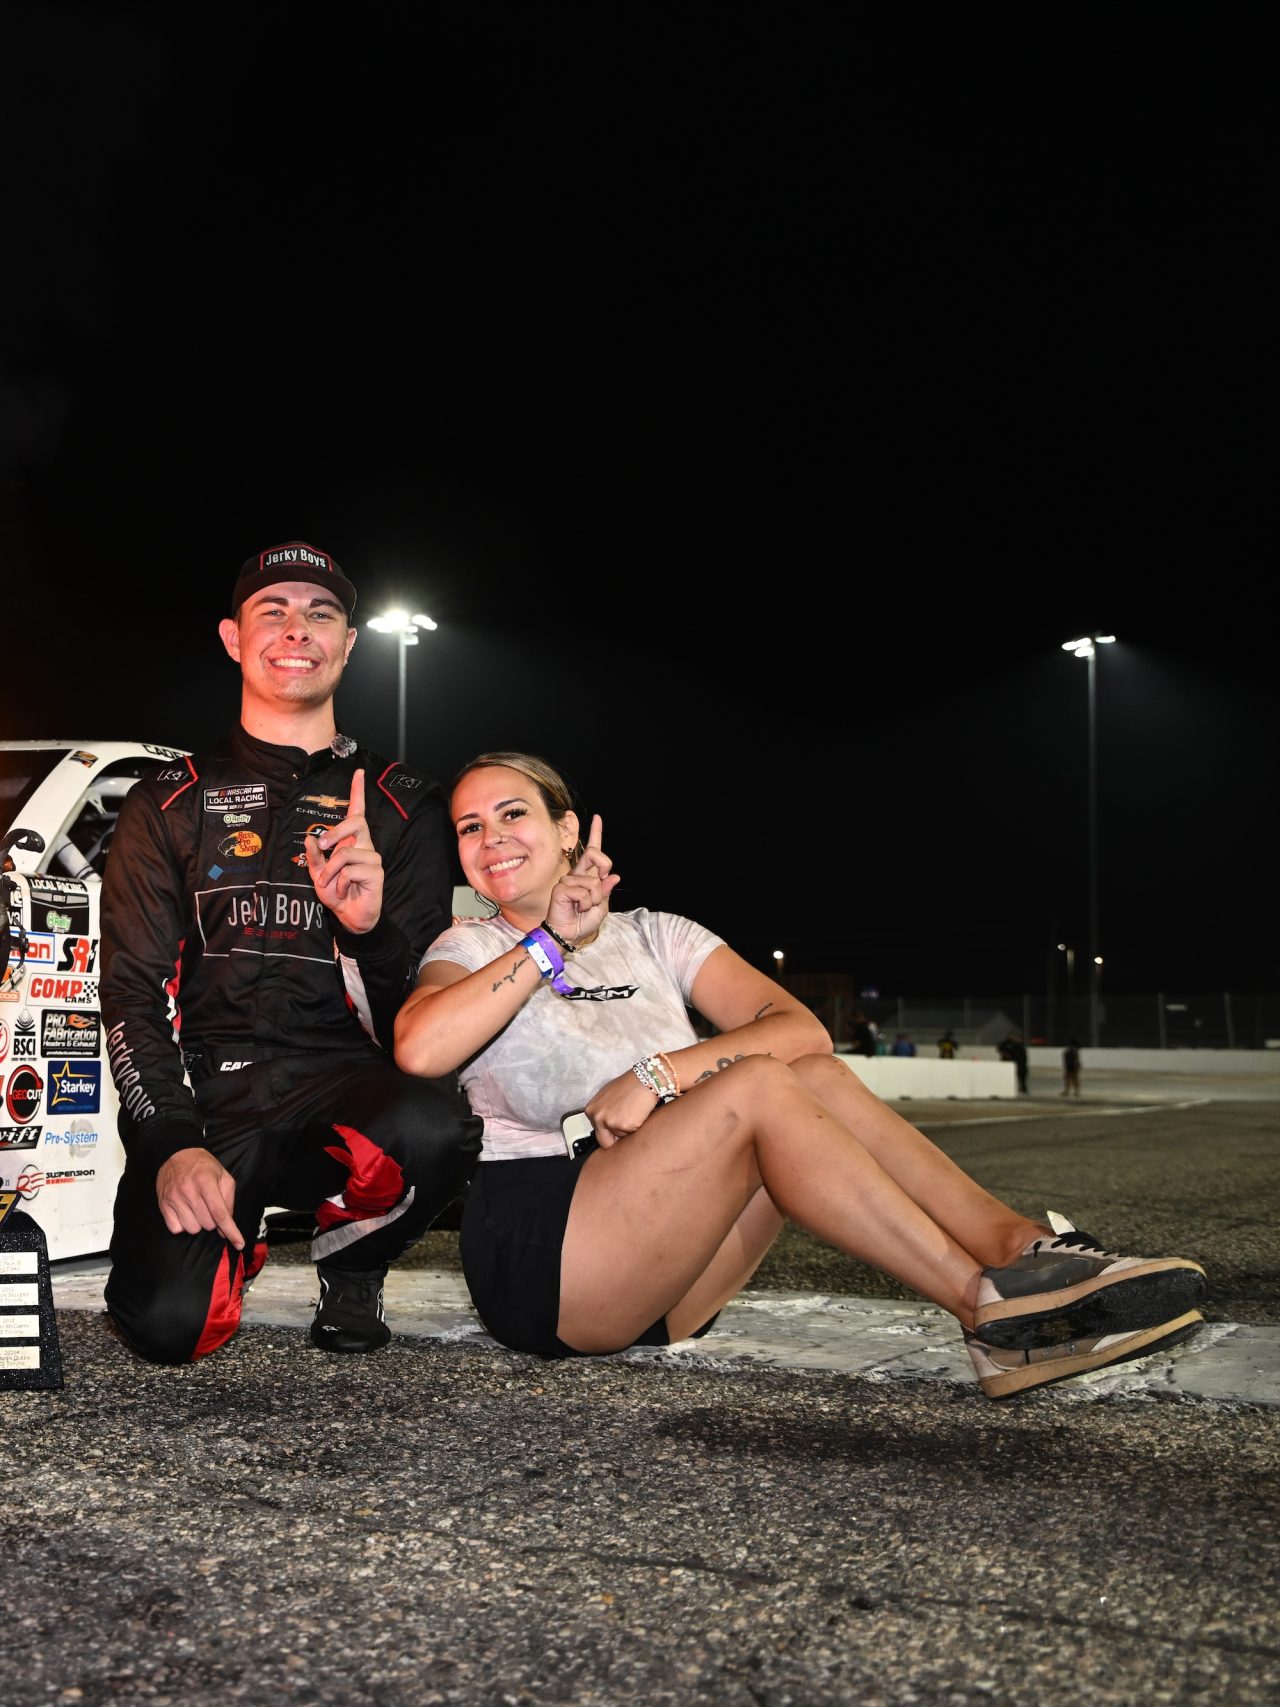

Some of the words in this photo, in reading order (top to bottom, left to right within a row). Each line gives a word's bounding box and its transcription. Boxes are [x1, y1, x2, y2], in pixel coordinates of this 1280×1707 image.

[266, 549, 298, 566] Jerky
[300, 549, 326, 568] Boys
[209, 797, 234, 805] LOCAL
[235, 793, 264, 803] RACING
[227, 787, 253, 797] NASCAR
[296, 807, 347, 820] CHEVROL
[237, 831, 255, 839] Bass
[239, 838, 251, 846] Pro
[239, 844, 260, 854] Shops
[30, 878, 57, 890] LOCAL
[55, 881, 88, 893] RACING
[275, 893, 324, 931] Boys
[30, 978, 83, 999] COMP
[566, 988, 629, 1001] JRM
[64, 996, 93, 1004] CAMS
[46, 1013, 67, 1028] PRO
[43, 1027, 98, 1042] FABrication
[13, 1038, 36, 1056] BSCI
[60, 1079, 96, 1097] Starkey
[45, 1130, 99, 1146] Pro-System
[45, 1169, 96, 1178] SUSPENSION
